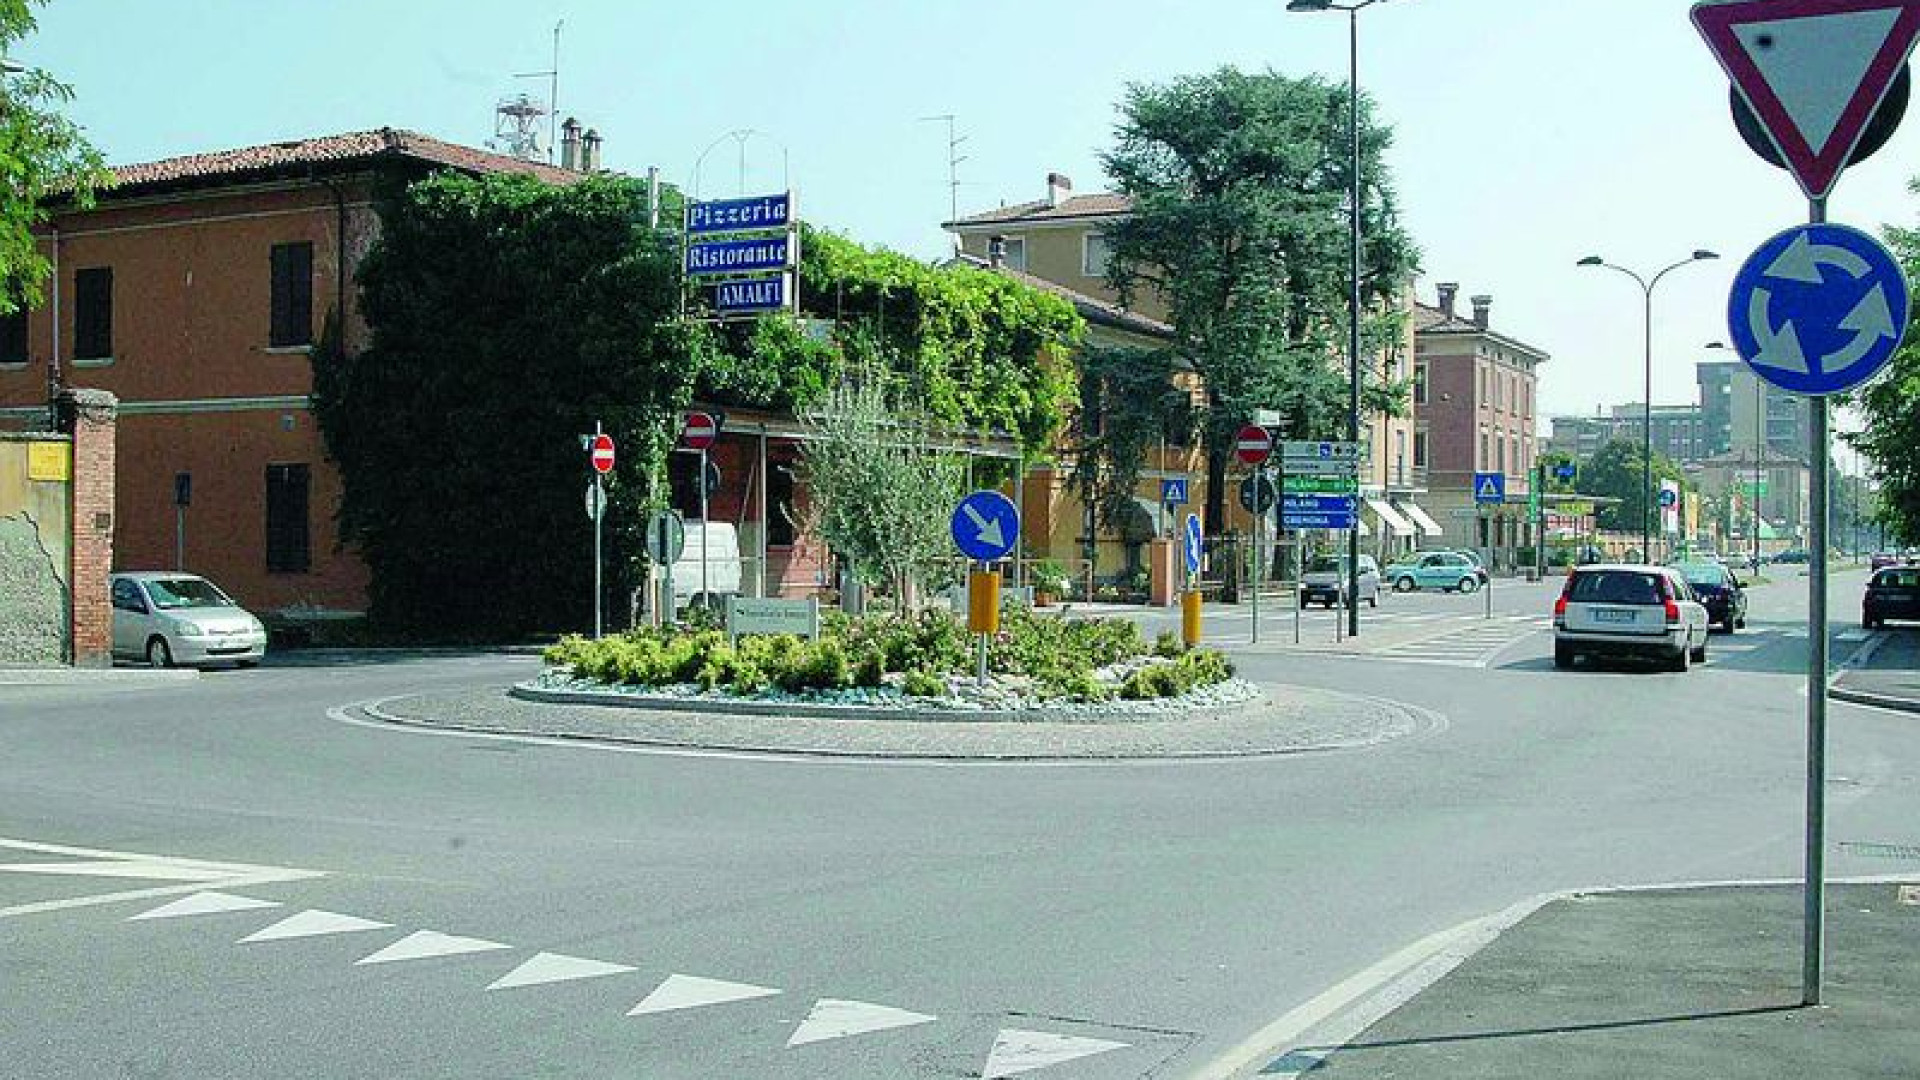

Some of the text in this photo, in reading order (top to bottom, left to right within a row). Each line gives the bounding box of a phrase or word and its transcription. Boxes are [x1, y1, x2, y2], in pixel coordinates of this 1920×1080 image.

[690, 199, 786, 226] Pizzeria
[690, 244, 786, 268] Ristorante
[721, 282, 780, 305] AMALFI
